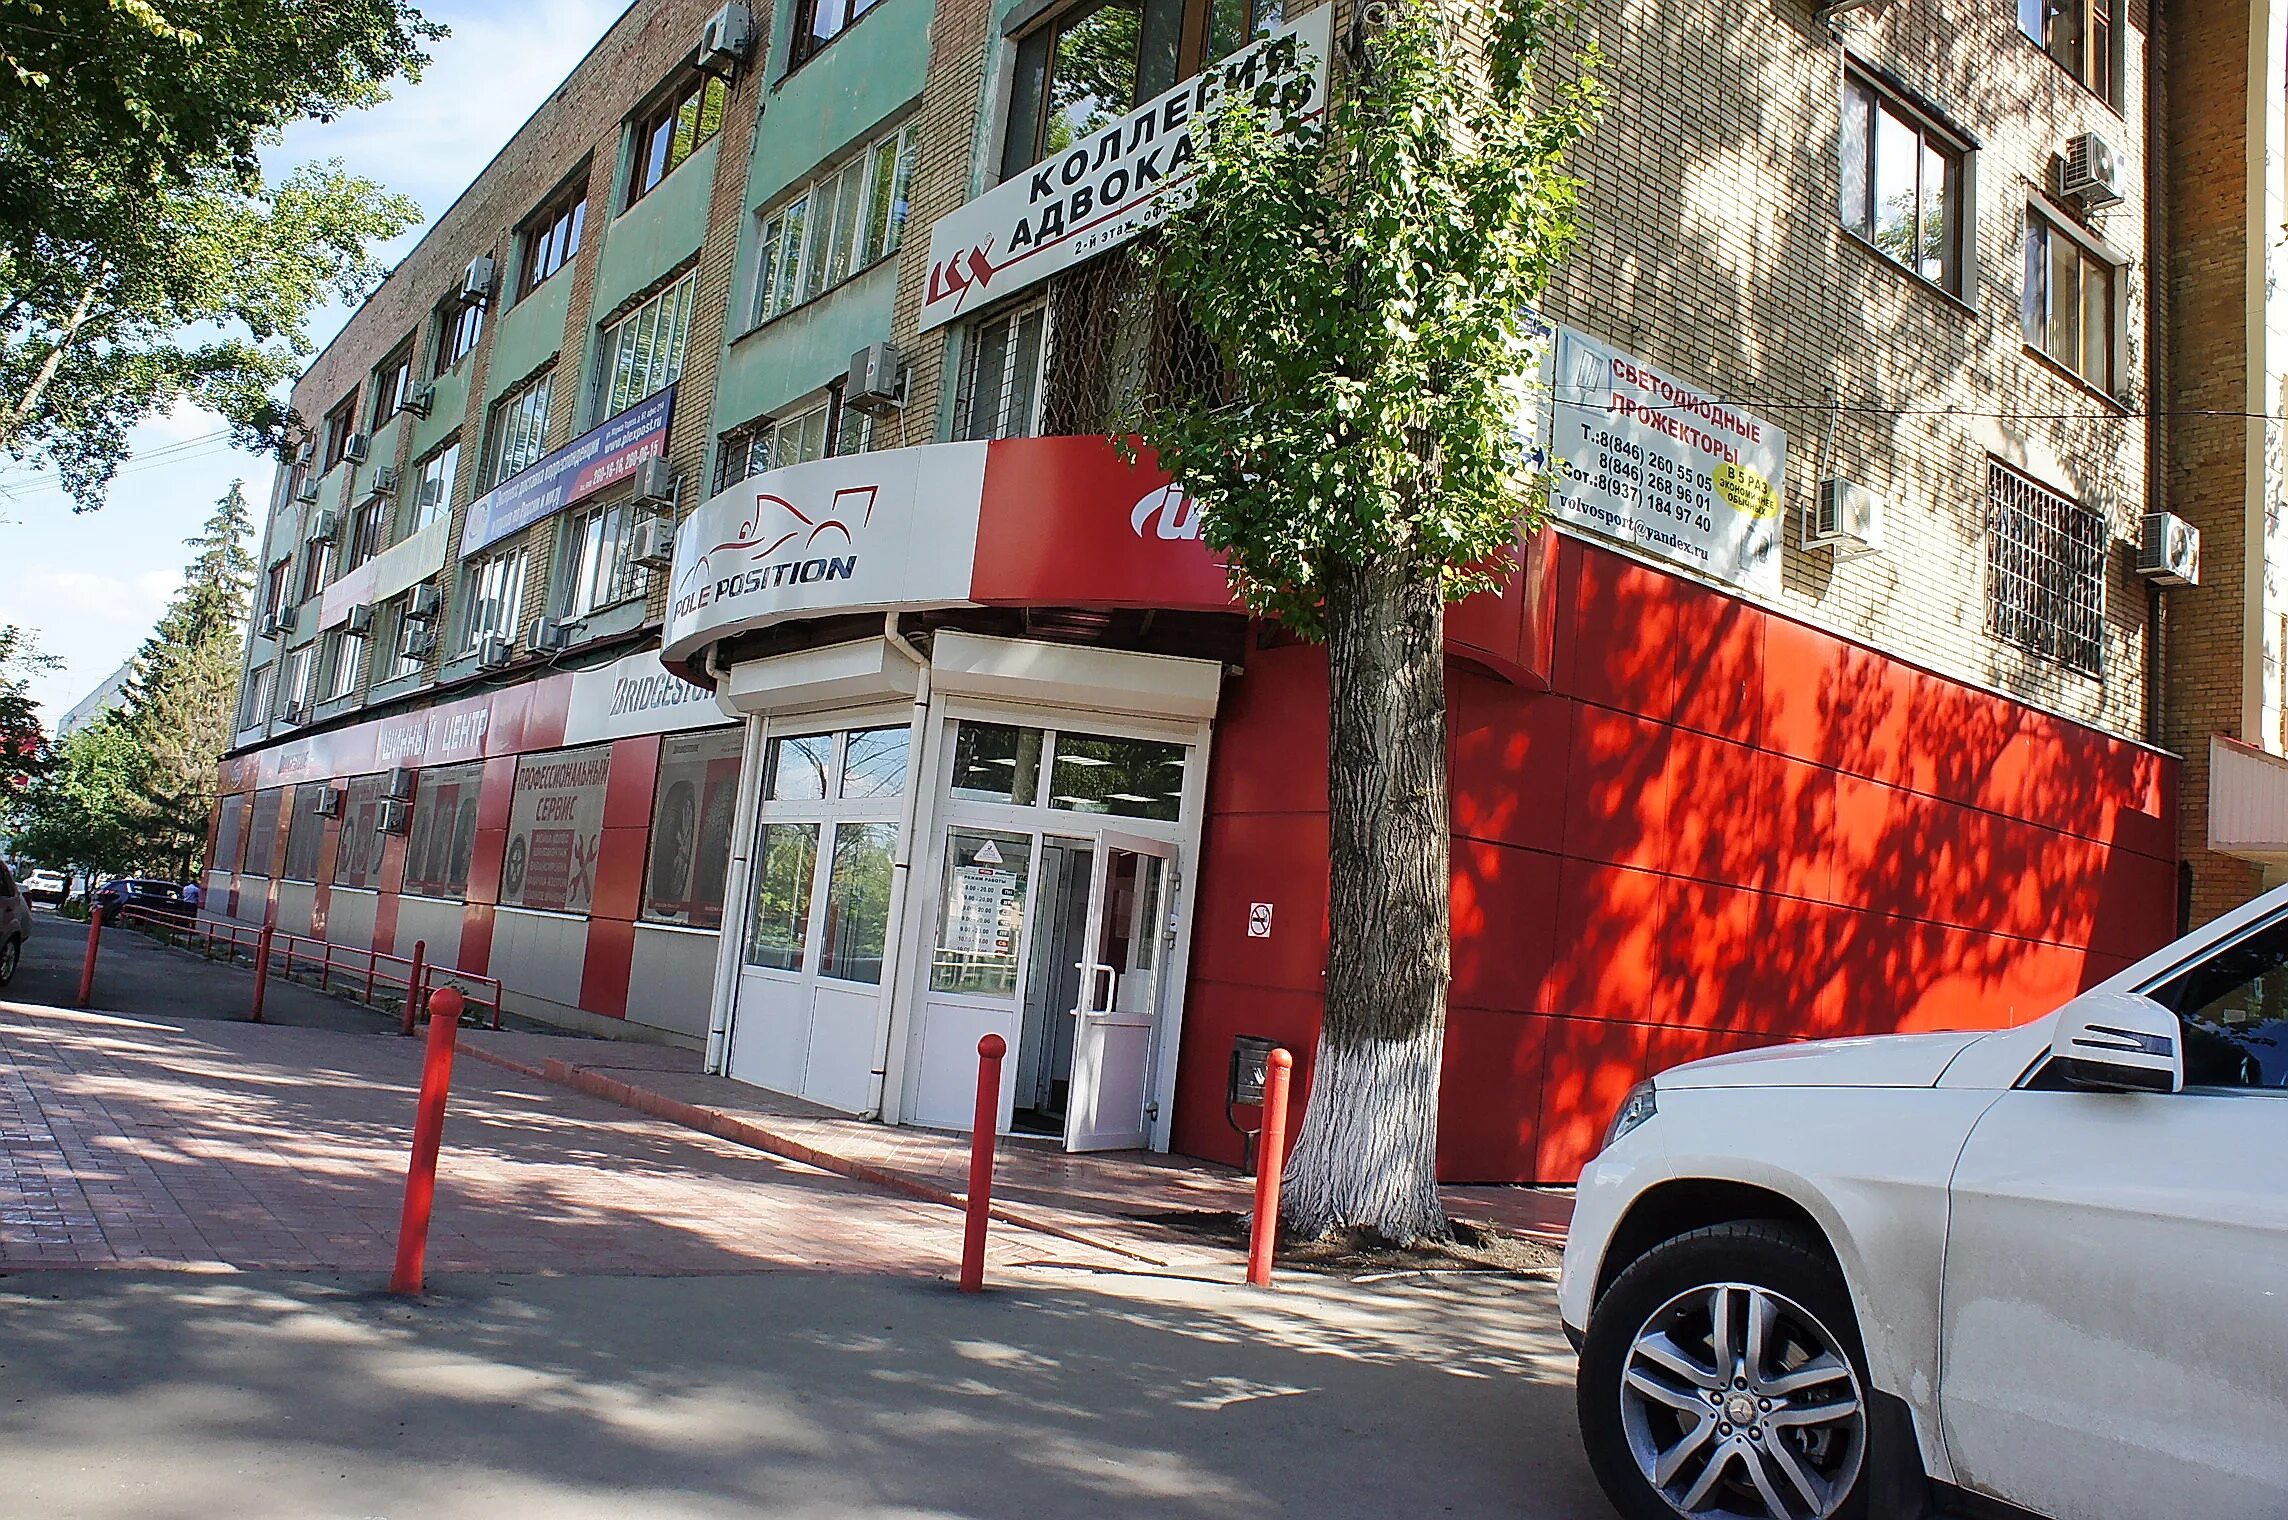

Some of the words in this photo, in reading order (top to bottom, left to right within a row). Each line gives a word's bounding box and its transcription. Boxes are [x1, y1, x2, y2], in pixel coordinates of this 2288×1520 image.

[1073, 232, 1097, 255] 2-й
[1612, 358, 1761, 444] СВЕТОДИОДНЫЕ
[1611, 392, 1739, 466] ПРОЖЕКТОРЫ
[1599, 452, 1644, 487] 8(846)
[1648, 473, 1673, 495] 268
[1676, 485, 1692, 504] 96
[1695, 493, 1710, 512] 01
[1648, 452, 1673, 474] 260
[1677, 464, 1693, 483] 55
[1696, 473, 1712, 492] 05
[1728, 466, 1735, 479] В
[1738, 471, 1744, 483] 5
[1748, 476, 1768, 495] РАЗ
[1647, 494, 1672, 516] 184
[1675, 505, 1692, 524] 97
[1695, 514, 1711, 532] 40
[1727, 492, 1766, 516] ОБЫЧНЫХ
[1559, 495, 1709, 561] volvosport@yandex.ru
[673, 584, 712, 623] POLE
[714, 555, 858, 603] POSITION
[382, 714, 437, 760] ШИННЫЙ
[442, 708, 488, 758] ЦЕНТР
[517, 753, 610, 791] ПРОФЕССИОНАЛЬНЫЙ
[535, 796, 578, 822] СЕРВИС
